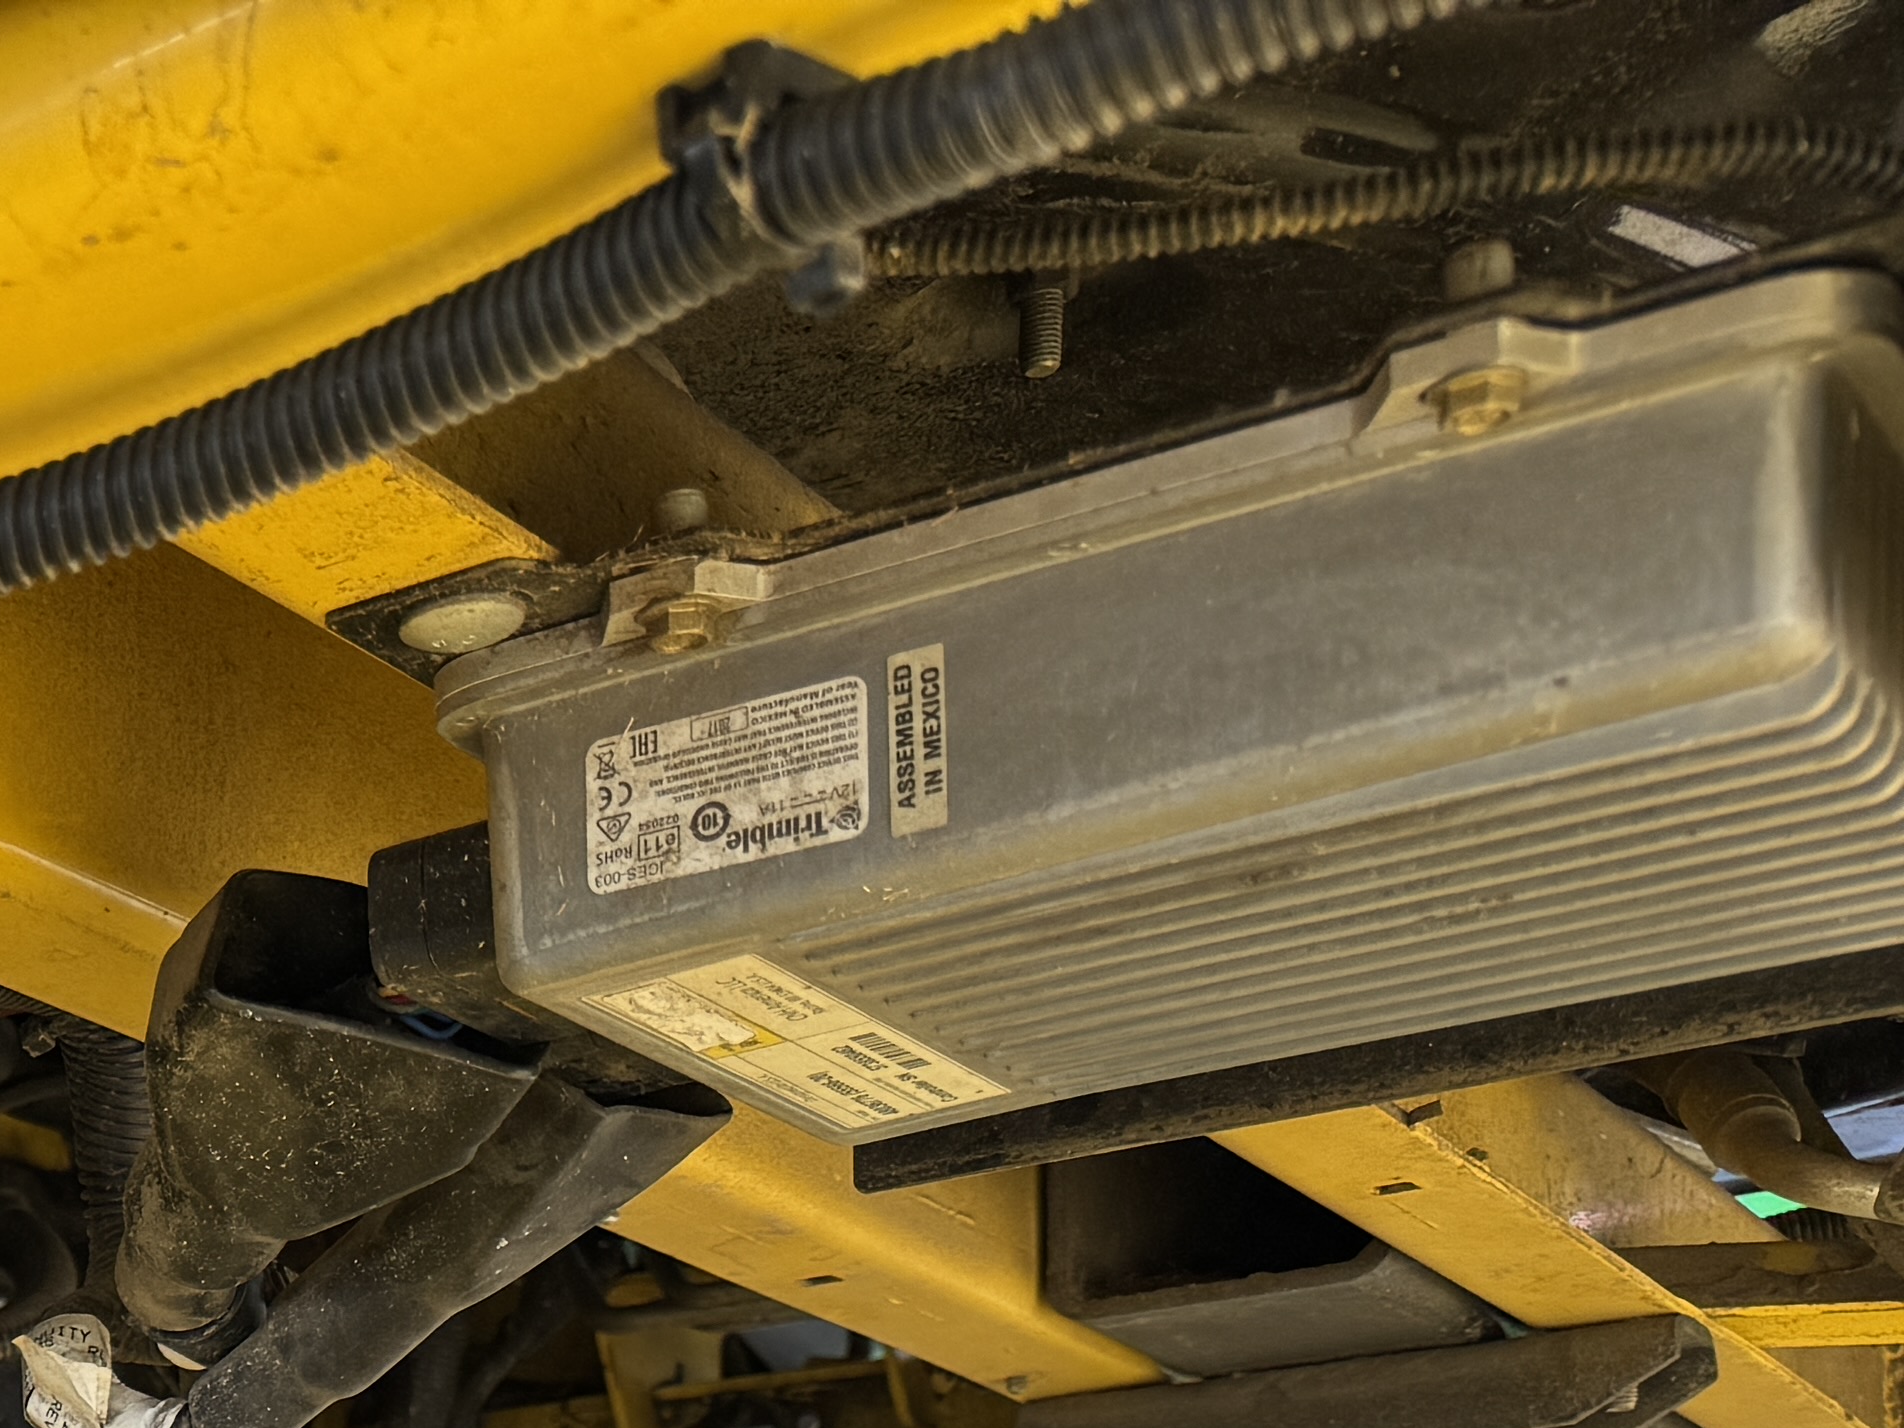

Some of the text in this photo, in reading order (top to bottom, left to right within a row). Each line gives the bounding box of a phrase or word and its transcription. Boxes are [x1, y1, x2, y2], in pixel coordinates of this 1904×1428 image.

[894, 664, 916, 808] ASSEMBLED
[921, 666, 943, 795] IN MEXICO
[701, 810, 718, 832] 10
[725, 809, 829, 852] Trimble
[595, 844, 632, 866] RoHS
[643, 831, 675, 855] e11
[594, 860, 664, 888] ICES-003
